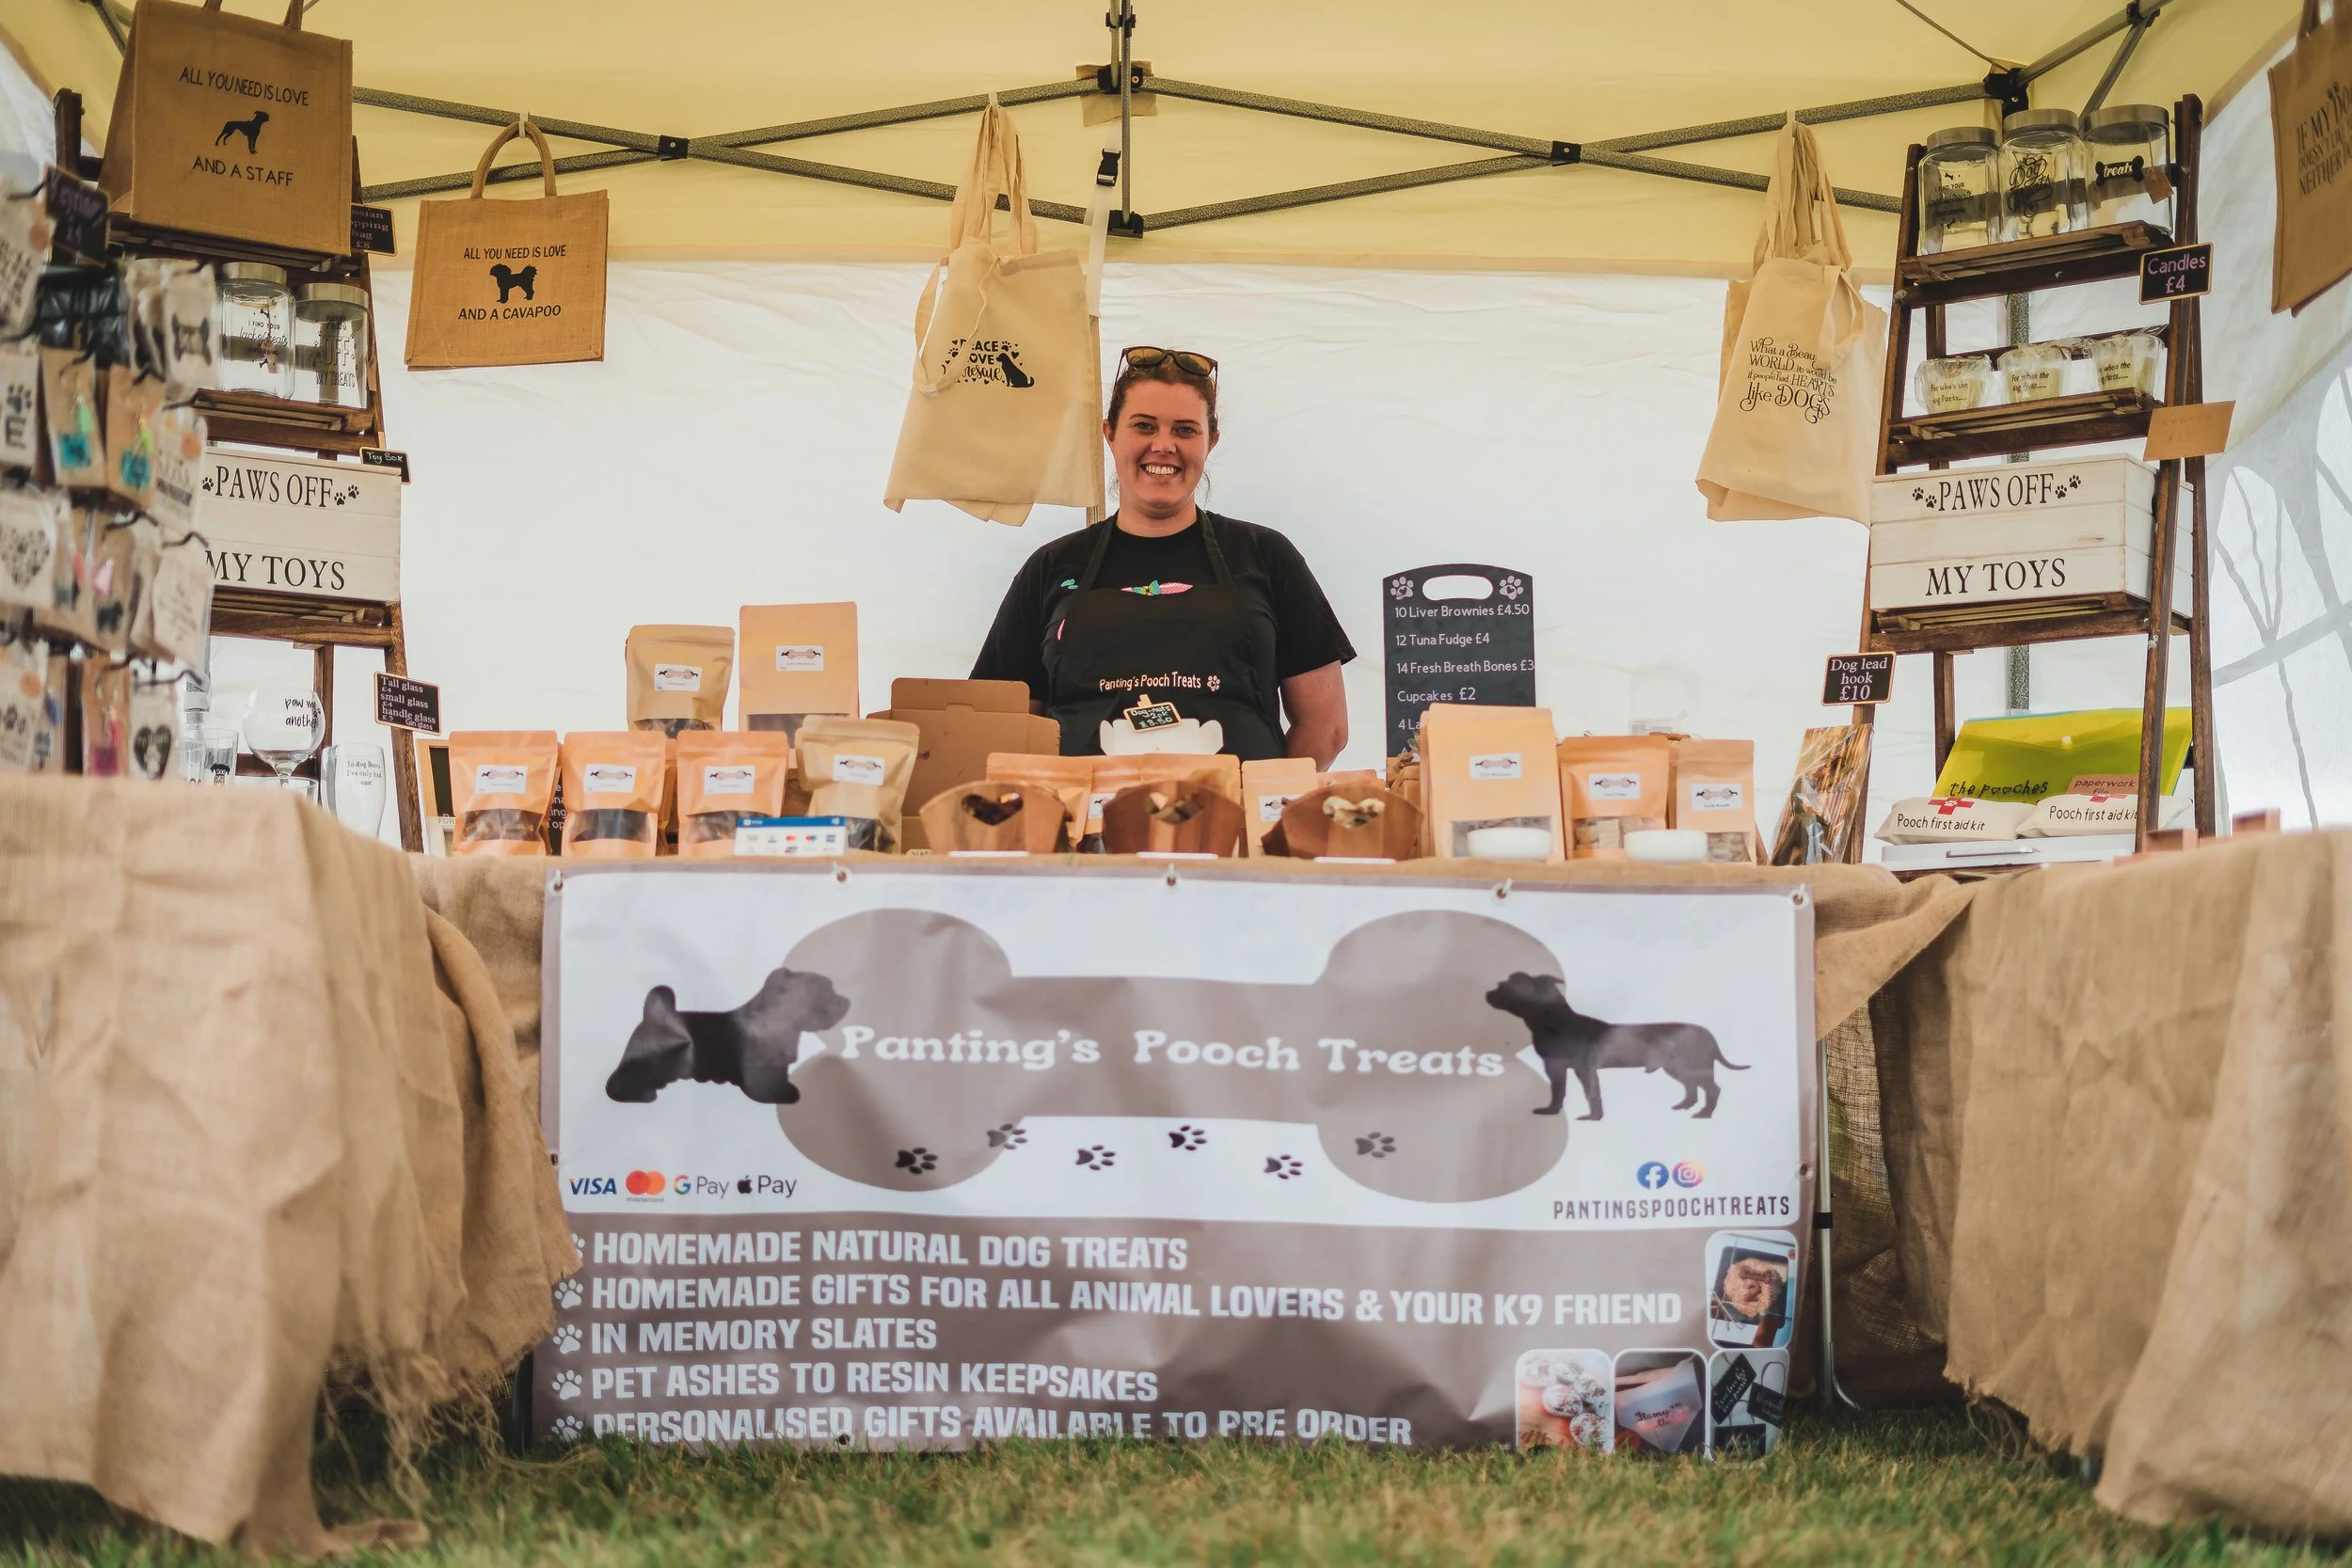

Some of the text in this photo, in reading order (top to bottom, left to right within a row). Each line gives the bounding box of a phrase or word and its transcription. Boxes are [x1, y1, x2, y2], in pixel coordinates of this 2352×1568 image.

[180, 66, 309, 106] ALL YOU NEED IS LOVE
[192, 155, 294, 186] AND A STAFF
[2103, 163, 2134, 179] treats
[463, 245, 566, 260] ALL YOU NEED IS LOVE
[2148, 253, 2206, 275] Candles
[2166, 275, 2185, 293] £4
[458, 304, 562, 321] AND A CAVAPOO
[324, 335, 350, 367] OFF
[1751, 337, 1774, 354] What
[1787, 343, 1817, 361] Beau
[961, 365, 1003, 381] rescue
[1749, 354, 1795, 372] WORLD
[1805, 368, 1827, 380] would
[1828, 372, 1836, 384] be
[1775, 372, 1789, 383] had
[1791, 373, 1835, 398] HEARTS
[1740, 382, 1831, 423] like DOGS
[366, 451, 403, 464] Toy Box
[215, 466, 279, 503] PAWS
[286, 474, 333, 508] OFF
[1938, 473, 2054, 512] PAWS OFF
[205, 550, 345, 591] MY TOYS
[1925, 558, 2066, 596] MY TOYS
[1395, 604, 1530, 618] 10 Liver Brownies £4.50
[1396, 633, 1490, 647] 12 Tuna Fudge £4
[1397, 663, 1408, 674] 14
[1410, 662, 1441, 673] Fresh
[1443, 661, 1482, 673] Breath
[1484, 660, 1518, 672] Bones
[1830, 657, 1887, 673] Dog lead
[380, 675, 423, 693] Tall glass
[1099, 671, 1201, 692] Panting's Pooch Treats
[1840, 672, 1873, 685] hook
[380, 693, 429, 709] small glass
[1397, 687, 1476, 704] Cupcakes £2
[1839, 685, 1870, 702] £10
[285, 698, 304, 710] paw
[285, 714, 319, 730] another
[382, 705, 437, 724] handle glass
[1139, 717, 1173, 728] £3.50
[418, 720, 434, 731] glass
[1398, 719, 1406, 730] 4
[1949, 781, 1976, 797] the
[2074, 779, 2136, 788] paperwork
[2049, 806, 2137, 821] Pooch first aid kit
[1898, 814, 1985, 832] Pooch first aid kit
[841, 1025, 1505, 1076] Panting's Pooch Treats
[568, 1178, 617, 1196] VISA
[696, 1175, 730, 1199] Pay
[757, 1175, 797, 1198] Pay
[1553, 1196, 1789, 1219] PANTINGSPOOCHTREATS
[593, 1229, 1187, 1271] HOMEMADE NATURAL DOG TREATS
[592, 1274, 1681, 1325] HOMEMADE GIFTS FOR ALL ANIMAL LOVERS & YOUR K9 FRIEND
[591, 1318, 937, 1354] IN MEMORY SLATES
[591, 1361, 1158, 1402] PET ASHES TO RESIN KEEPSAKES
[593, 1406, 1411, 1445] PERSONALISED GIFTS AVAILABLE TO PRE ORDER
